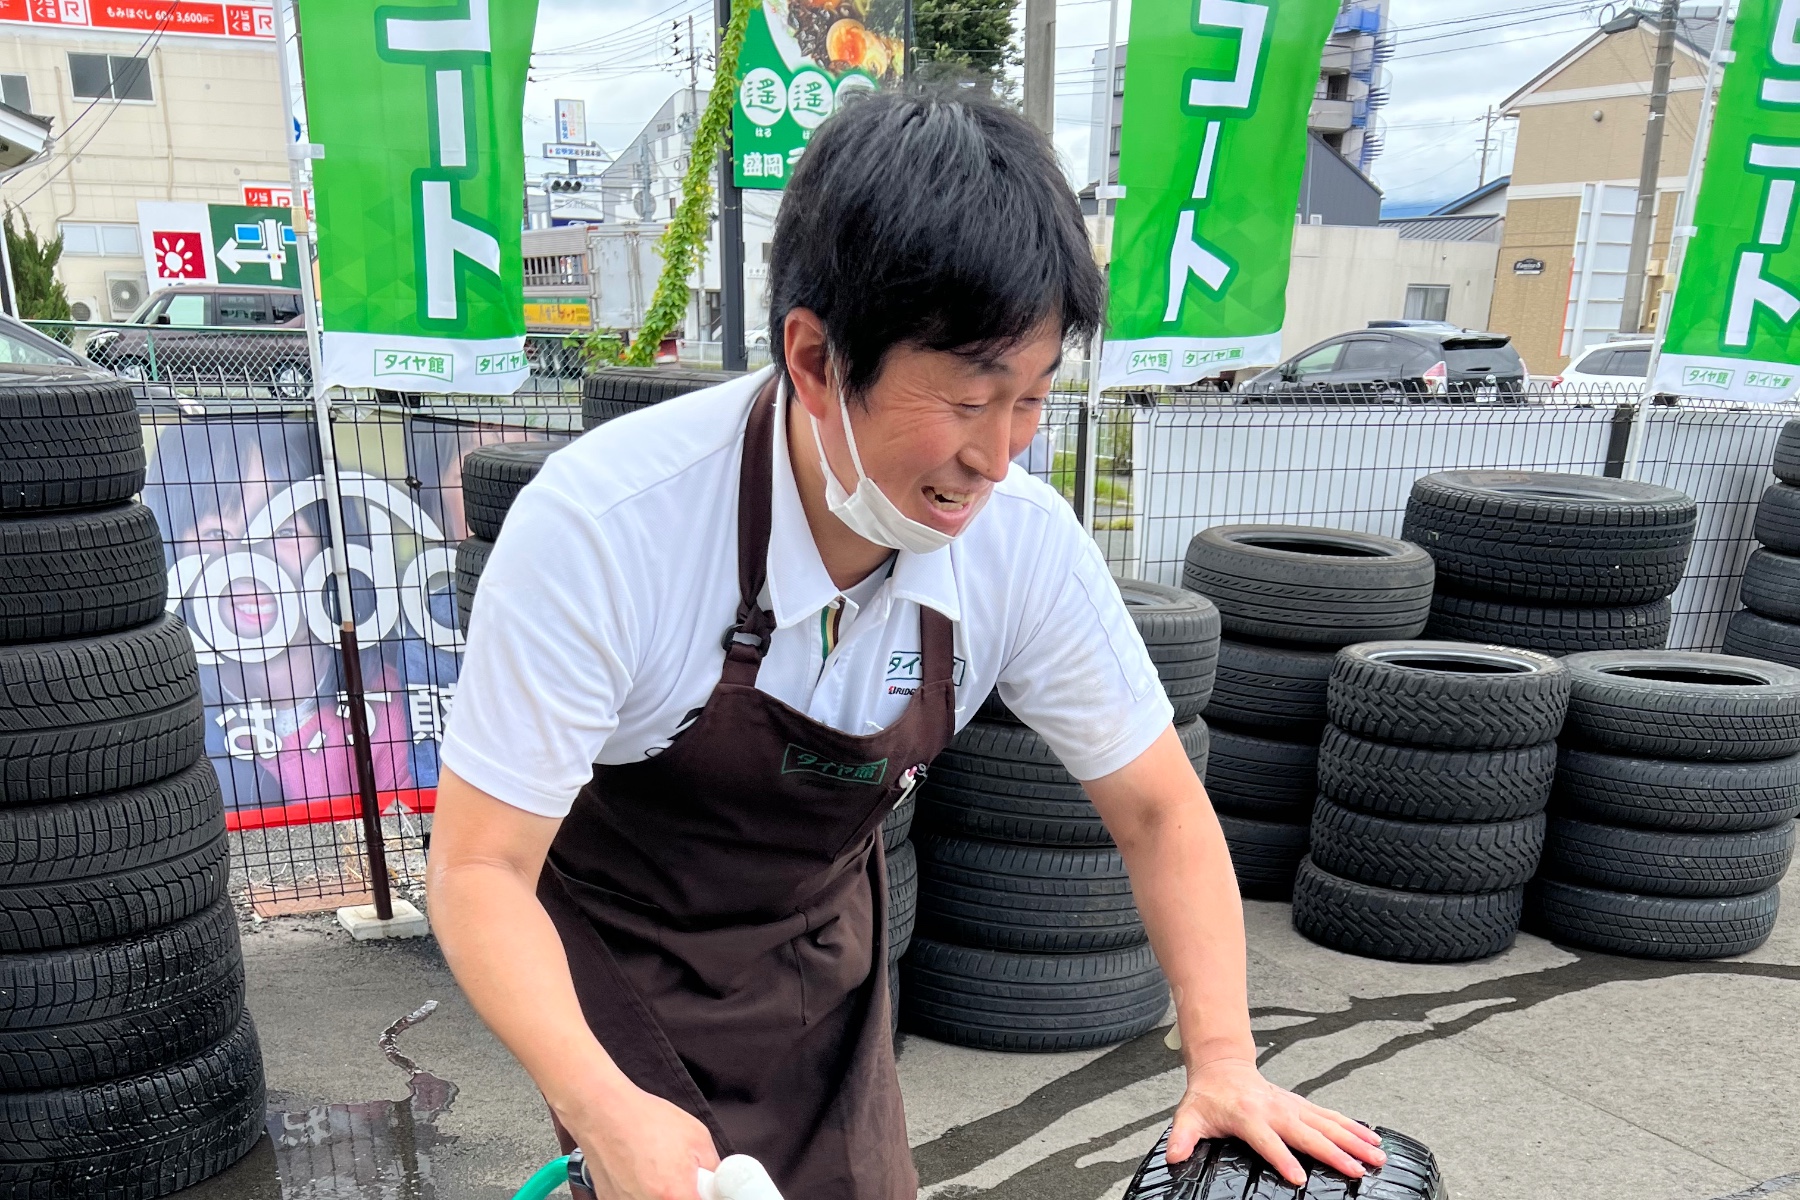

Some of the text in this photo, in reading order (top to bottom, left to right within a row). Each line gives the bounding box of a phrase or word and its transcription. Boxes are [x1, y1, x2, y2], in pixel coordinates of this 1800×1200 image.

[107, 6, 153, 20] もみほぐし
[755, 127, 772, 138] はる
[1163, 0, 1269, 322] コート
[384, 354, 445, 374] タイヤ館
[1132, 353, 1168, 368] タイヤ館
[1185, 349, 1241, 365] タイヤ館
[1689, 369, 1729, 385] タイヤ館
